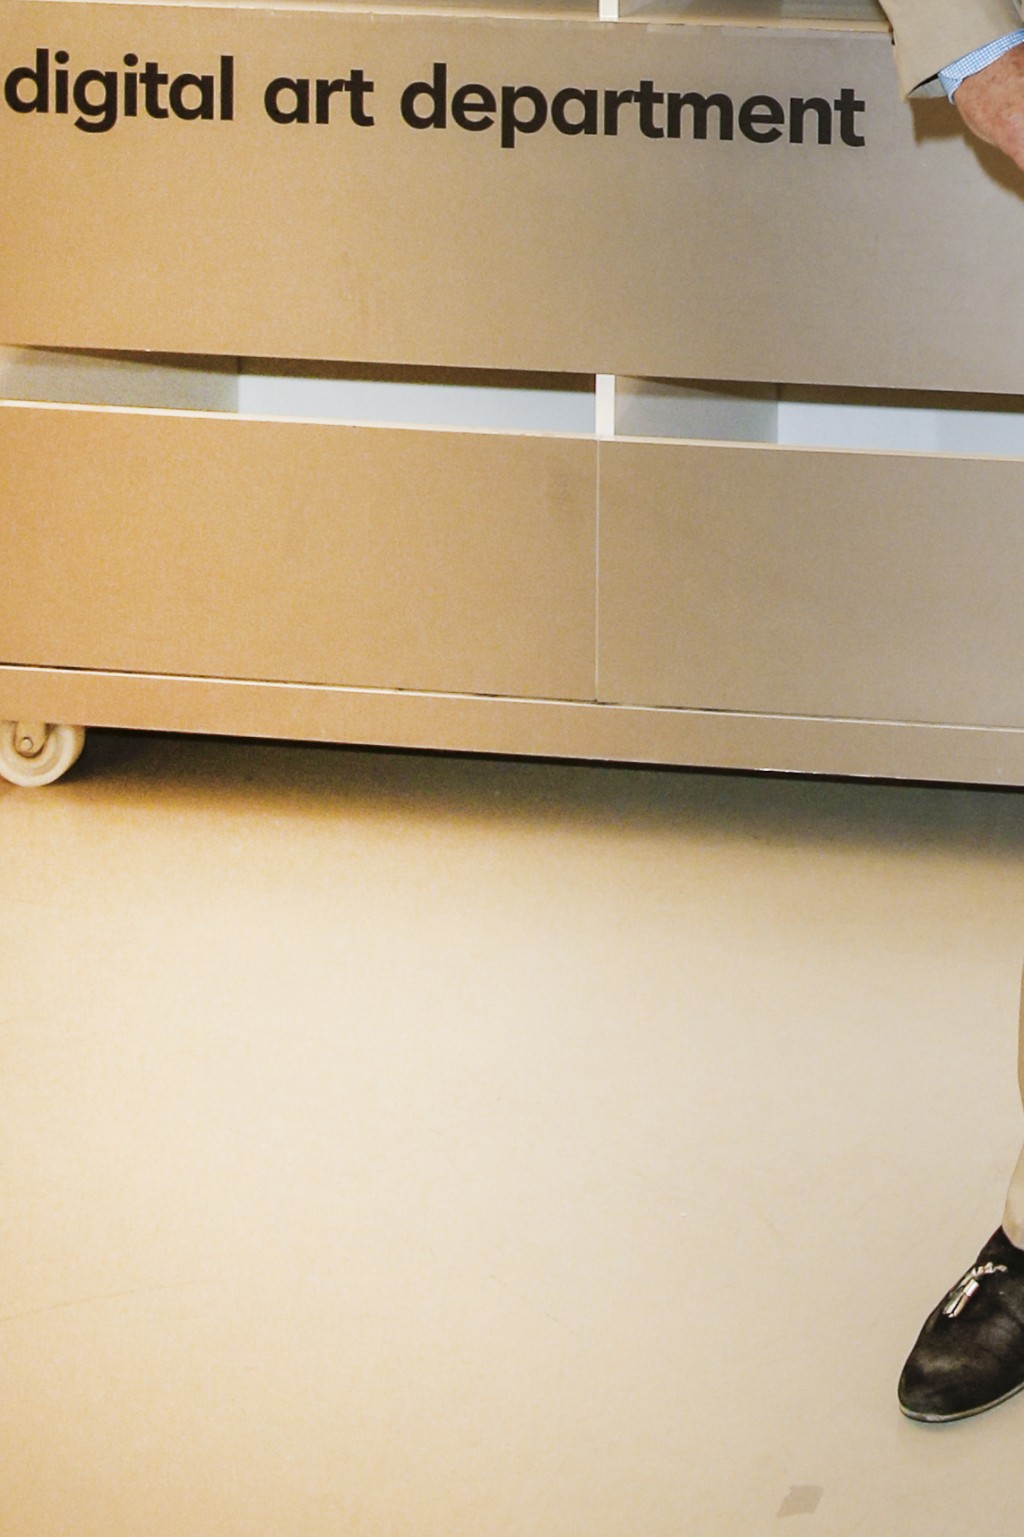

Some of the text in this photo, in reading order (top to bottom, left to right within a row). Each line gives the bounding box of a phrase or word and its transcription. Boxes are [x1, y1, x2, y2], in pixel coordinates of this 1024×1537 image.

[4, 48, 866, 149] digital art department
